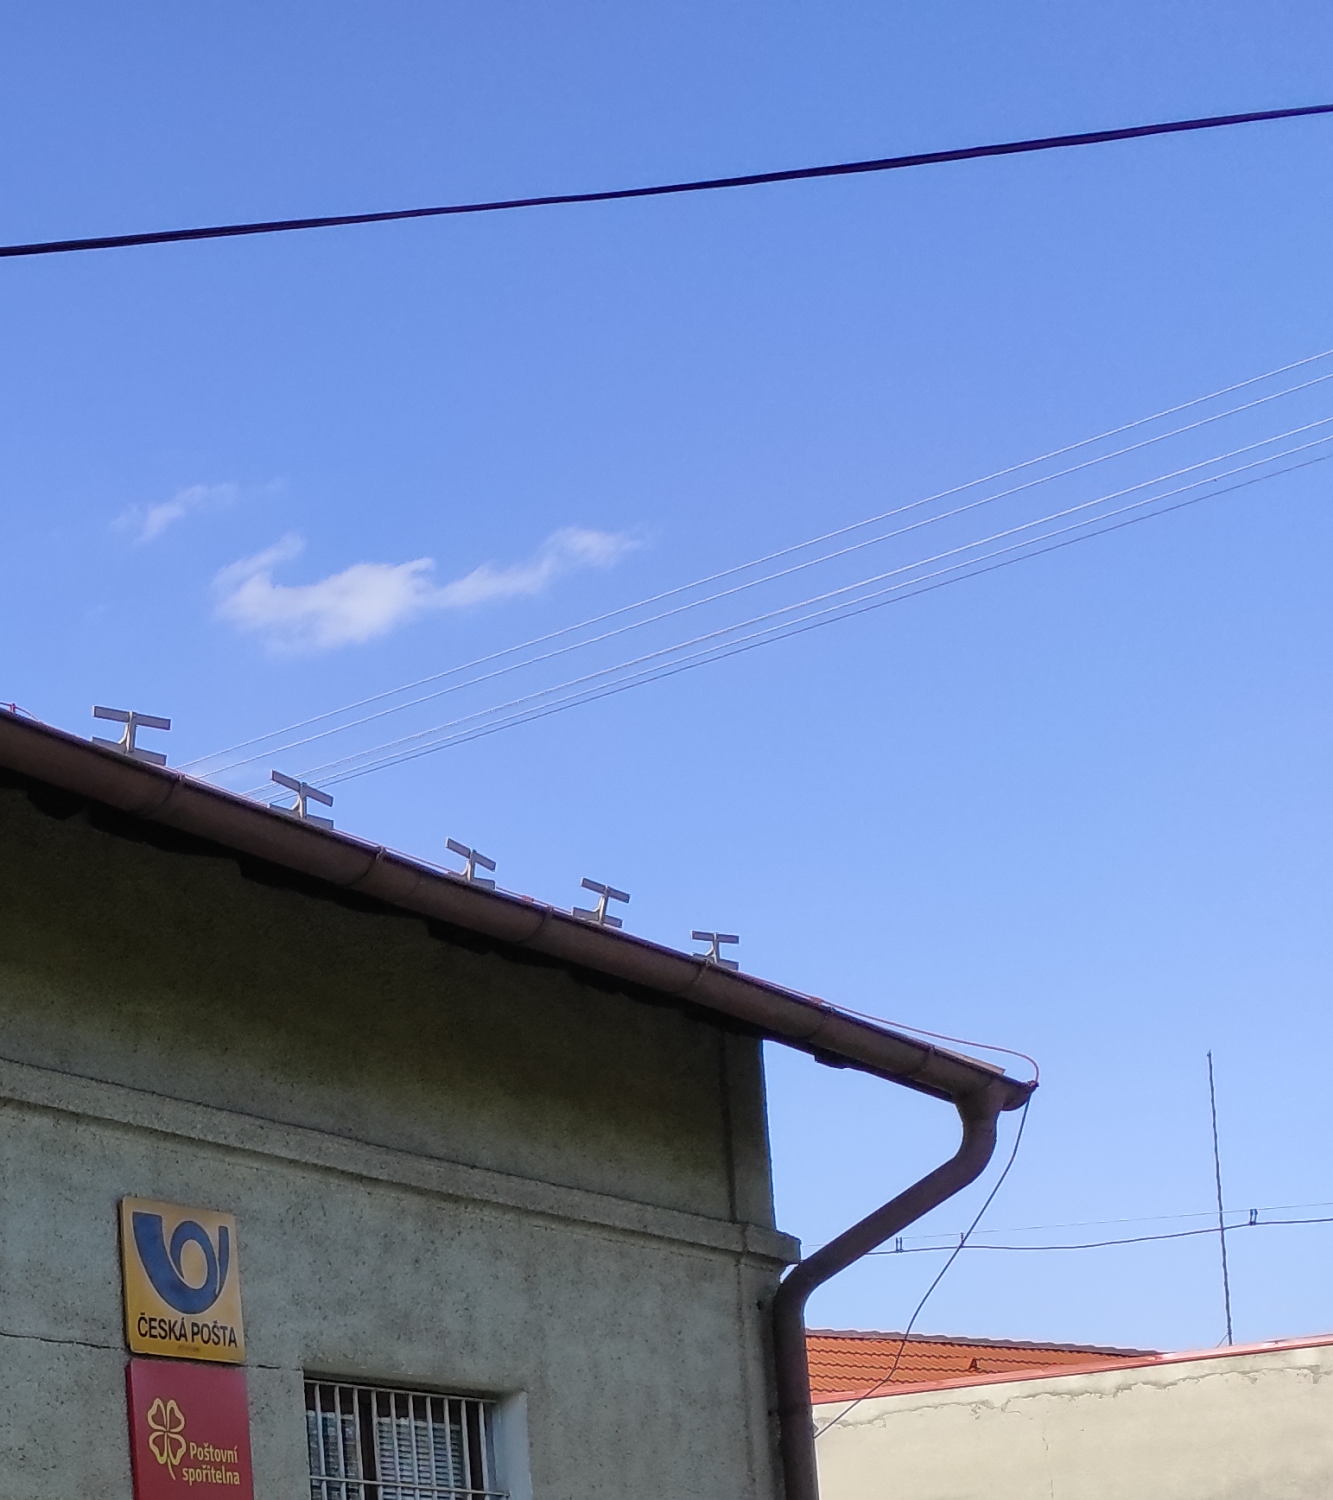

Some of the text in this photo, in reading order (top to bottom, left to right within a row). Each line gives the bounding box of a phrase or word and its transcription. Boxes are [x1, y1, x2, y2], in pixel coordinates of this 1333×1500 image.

[137, 1312, 237, 1348] ČESKÁ POŠTA
[189, 1442, 238, 1464] Poštovní
[182, 1464, 240, 1486] spořitelna
